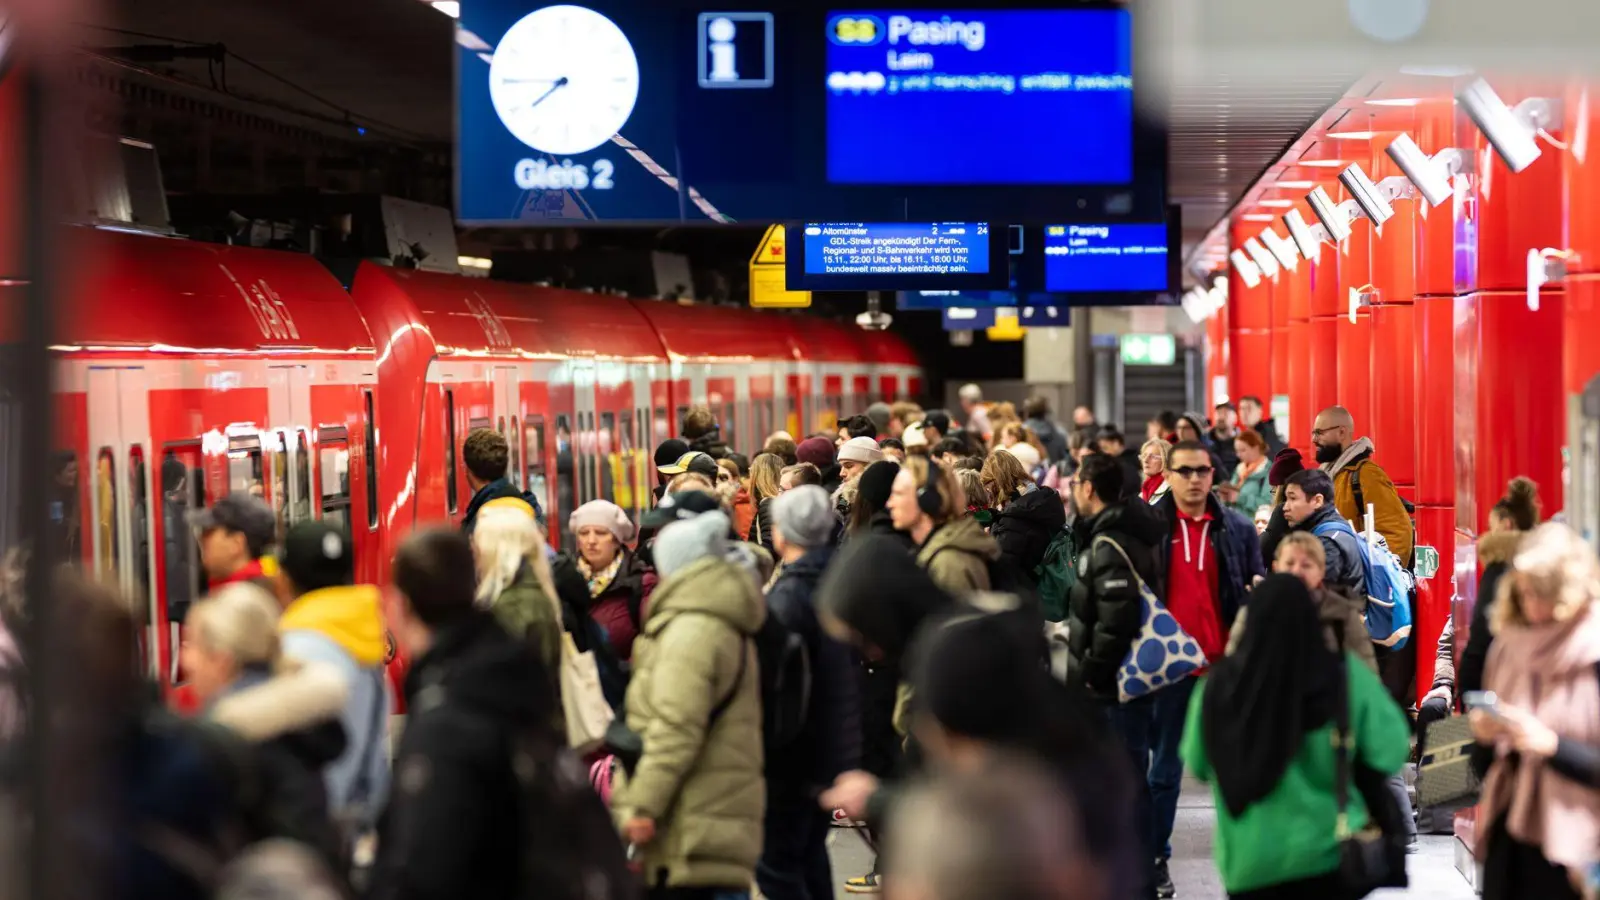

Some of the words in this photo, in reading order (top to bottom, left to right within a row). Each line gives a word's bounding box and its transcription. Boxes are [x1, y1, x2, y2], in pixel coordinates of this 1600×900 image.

[888, 16, 985, 50] Pasing
[514, 158, 589, 189] Gleis
[592, 158, 614, 189] 2
[823, 227, 868, 235] Altomünster
[931, 226, 939, 235] 2
[977, 226, 988, 235] 24
[1069, 225, 1108, 238] Pasing
[830, 237, 872, 245] GDL-Streik
[873, 237, 921, 247] angekündigt!
[923, 237, 937, 245] Der
[823, 246, 860, 256] Regional-
[861, 246, 875, 254] und
[877, 246, 933, 254] S-Bahnverkehr
[934, 246, 950, 254] wird
[823, 255, 848, 264] 15.11.,
[849, 255, 871, 264] 22:00
[873, 255, 888, 264] Uhr,
[890, 255, 901, 264] bis
[904, 255, 928, 264] 16.11.,
[930, 255, 951, 264] 18:00
[826, 265, 868, 273] bundesweit
[870, 265, 896, 273] massiv
[898, 265, 948, 274] beeinträchtigt
[950, 265, 968, 273] sein.
